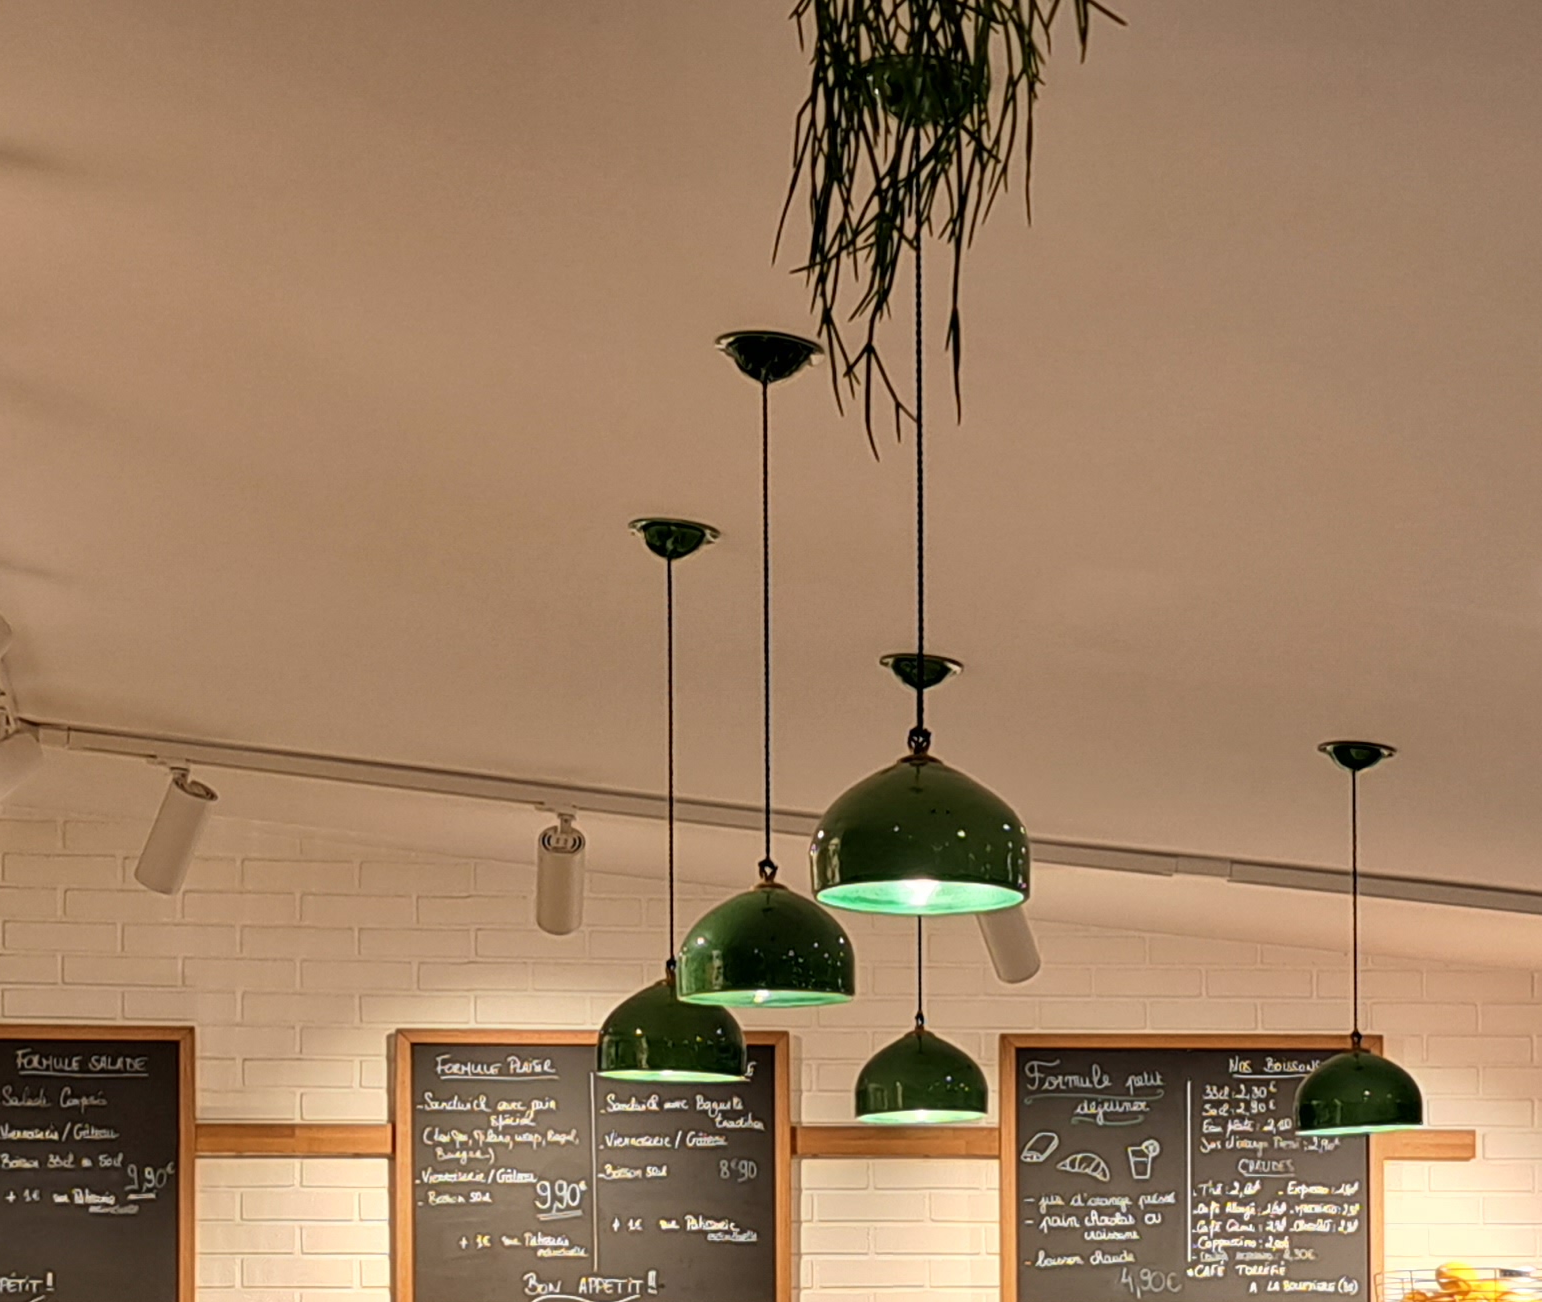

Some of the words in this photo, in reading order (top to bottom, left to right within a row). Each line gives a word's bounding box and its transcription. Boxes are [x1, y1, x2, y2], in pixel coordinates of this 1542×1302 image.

[15, 1047, 83, 1071] FORMULE
[88, 1055, 149, 1072] SALADE
[435, 1054, 503, 1075] FORMULE
[1228, 1055, 1253, 1073] NOS
[1024, 1059, 1113, 1091] Formule
[1125, 1071, 1166, 1096] petit
[2, 1085, 52, 1107] Salade
[424, 1091, 492, 1112] Sandwich
[1038, 1214, 1081, 1234] pain
[522, 1272, 562, 1296] BON
[1120, 1266, 1183, 1300] 4,90€
